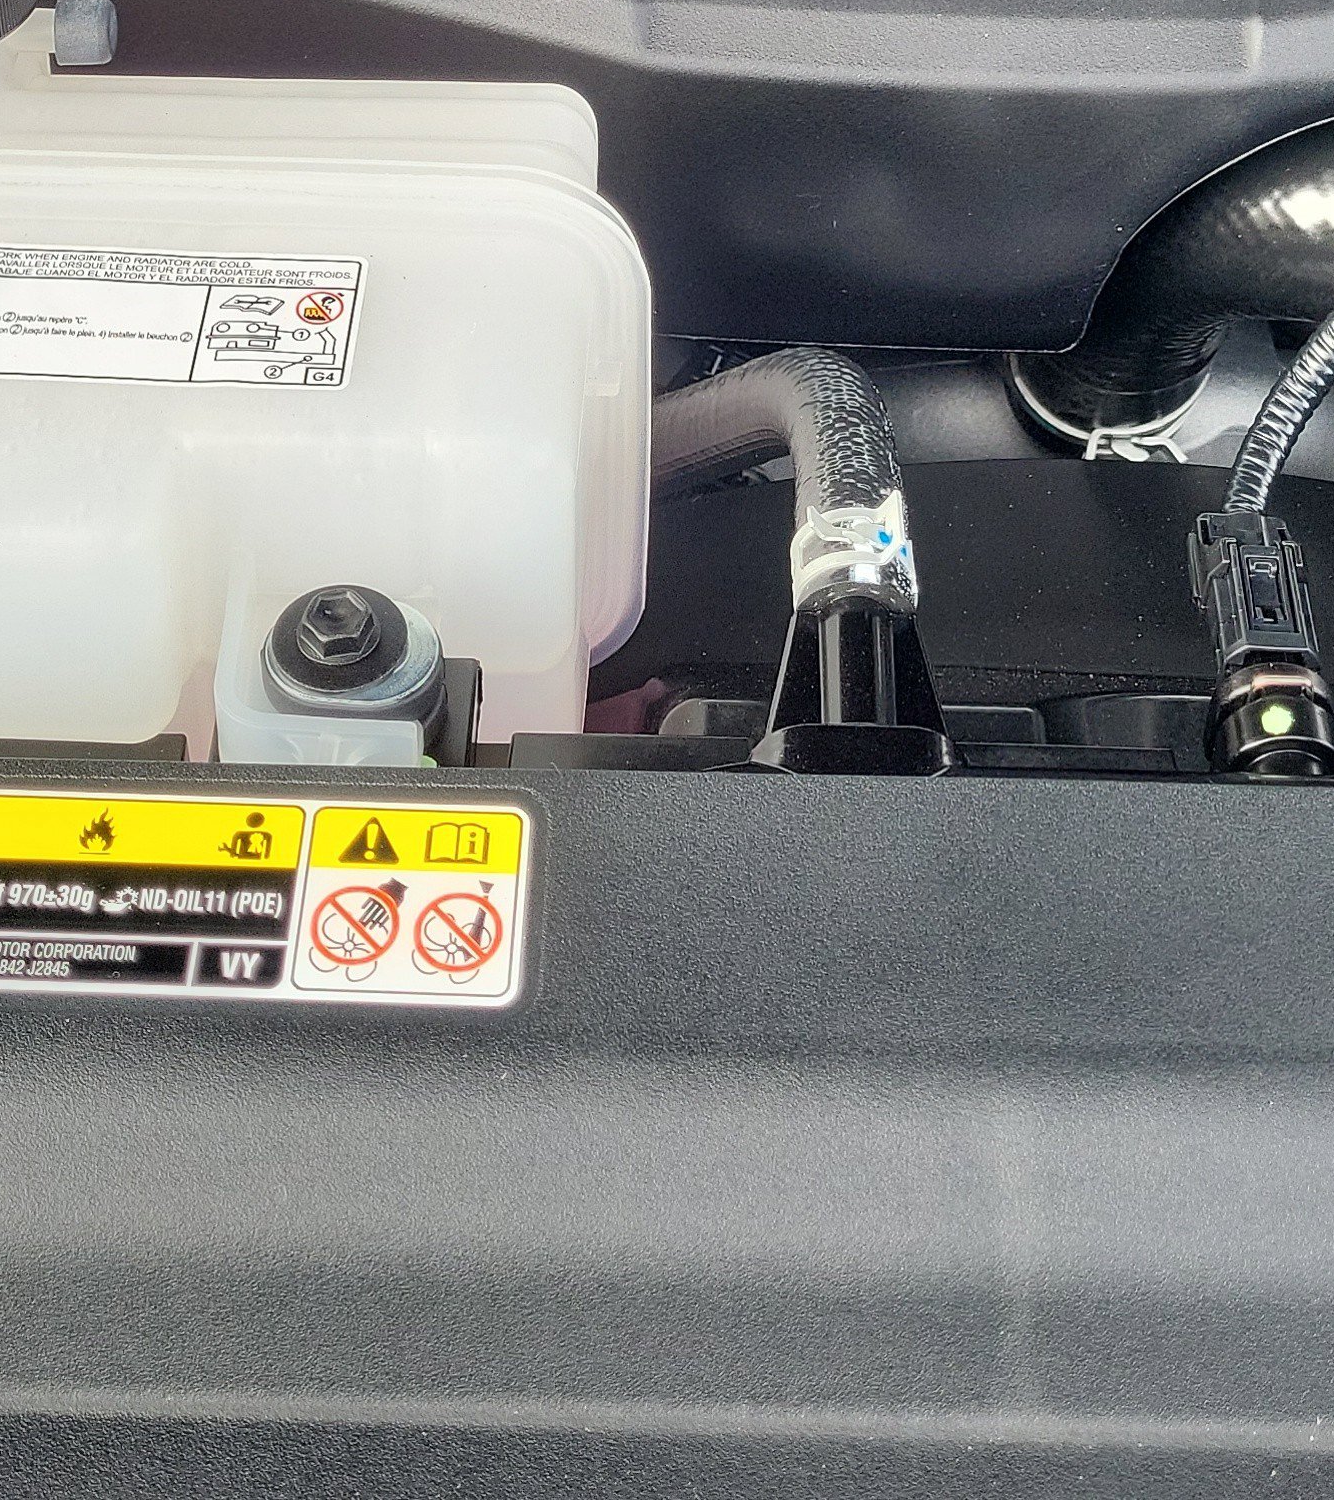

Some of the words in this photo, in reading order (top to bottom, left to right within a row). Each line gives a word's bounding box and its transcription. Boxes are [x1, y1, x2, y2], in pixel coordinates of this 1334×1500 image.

[24, 252, 59, 261] WHEN
[61, 253, 105, 262] ENGINE
[106, 255, 131, 264] AND
[133, 257, 191, 267] RADIATOR
[191, 259, 217, 268] ARE
[218, 260, 255, 268] COLD.
[35, 268, 85, 277] CUANDO
[103, 270, 146, 280] MOTOR
[174, 274, 235, 284] RADIADOR
[52, 260, 108, 270] LORSQUE
[125, 263, 174, 274] MOTEUR
[209, 267, 273, 277] RADIATEUR
[274, 269, 307, 278] SONT
[308, 270, 355, 280] FROIDS.
[312, 371, 335, 382] G4
[7, 883, 95, 911] 970±30g
[139, 887, 227, 913] ND-OIL11
[230, 891, 284, 919] (POE)
[33, 942, 137, 962] CORPORATION
[26, 960, 72, 978] J2845
[219, 951, 262, 980] VY
